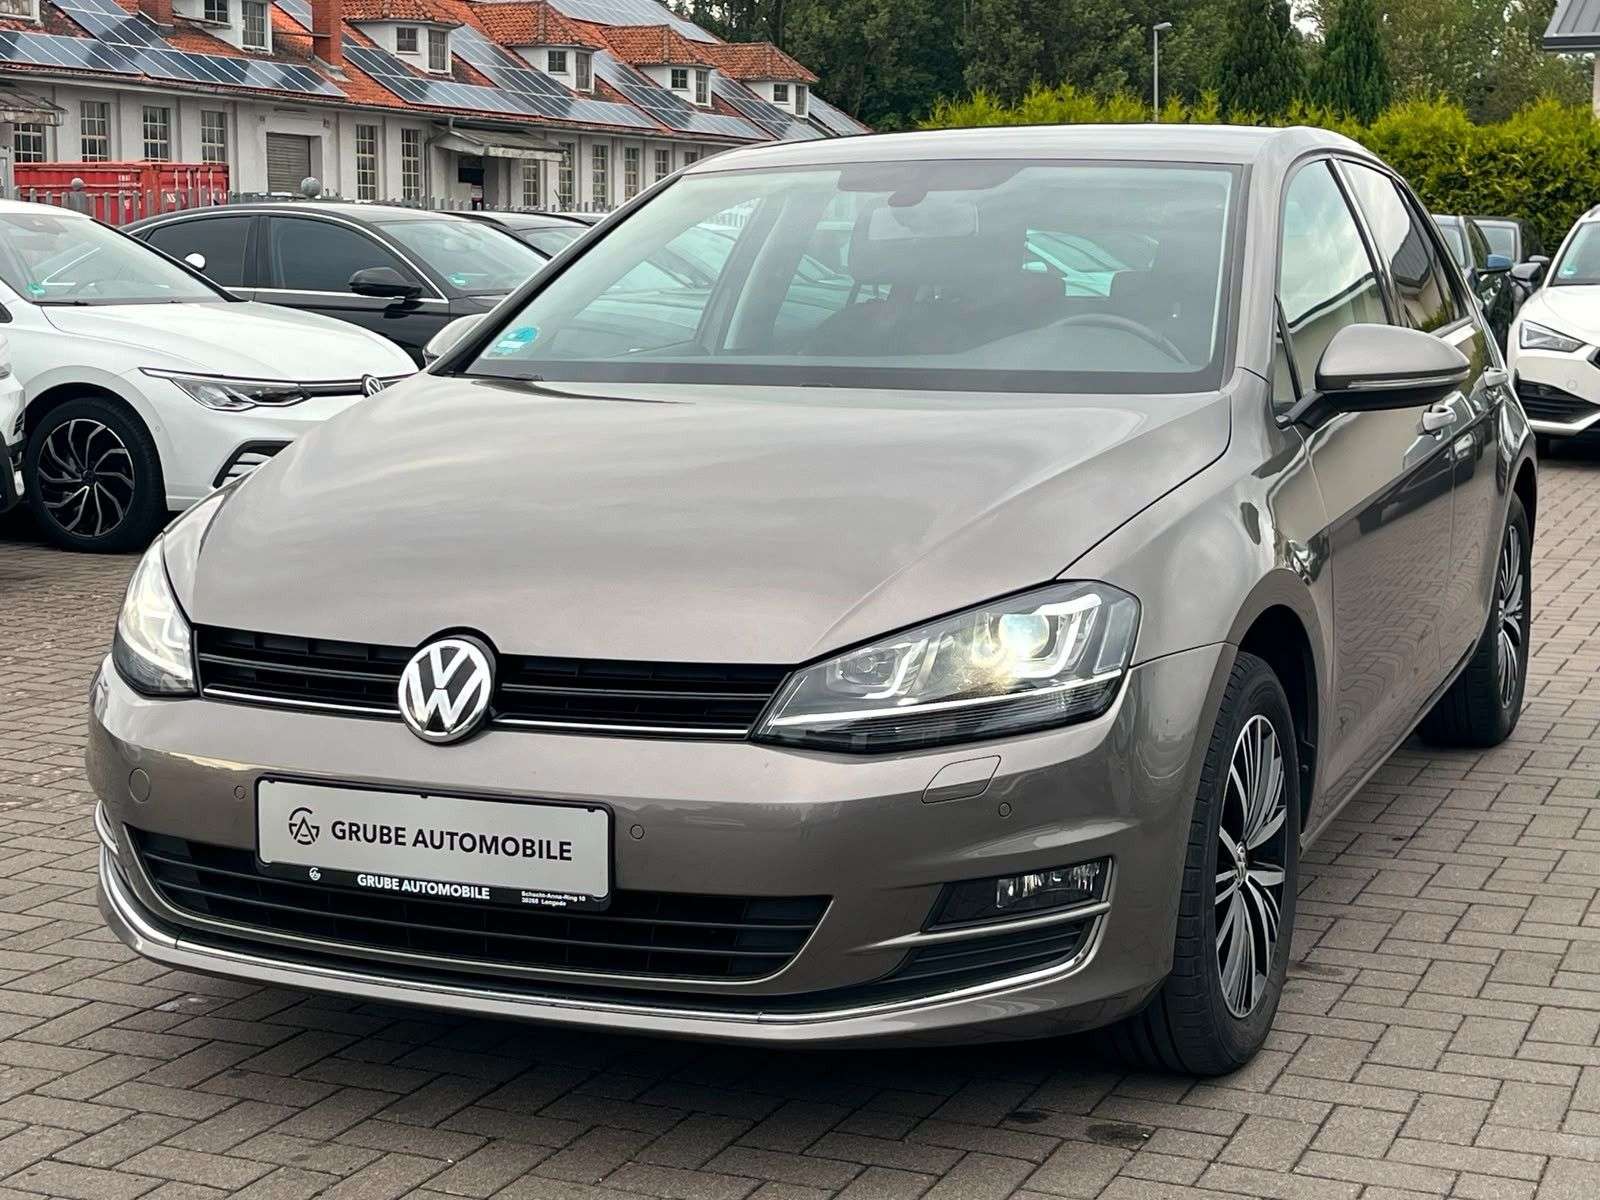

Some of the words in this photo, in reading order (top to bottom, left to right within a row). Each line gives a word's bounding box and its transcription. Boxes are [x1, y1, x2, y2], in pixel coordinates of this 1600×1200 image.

[331, 820, 406, 846] GRUBE
[412, 828, 572, 861] AUTOMOBILE
[357, 874, 400, 890] GRUBE
[401, 879, 490, 899] AUTOMOBILE
